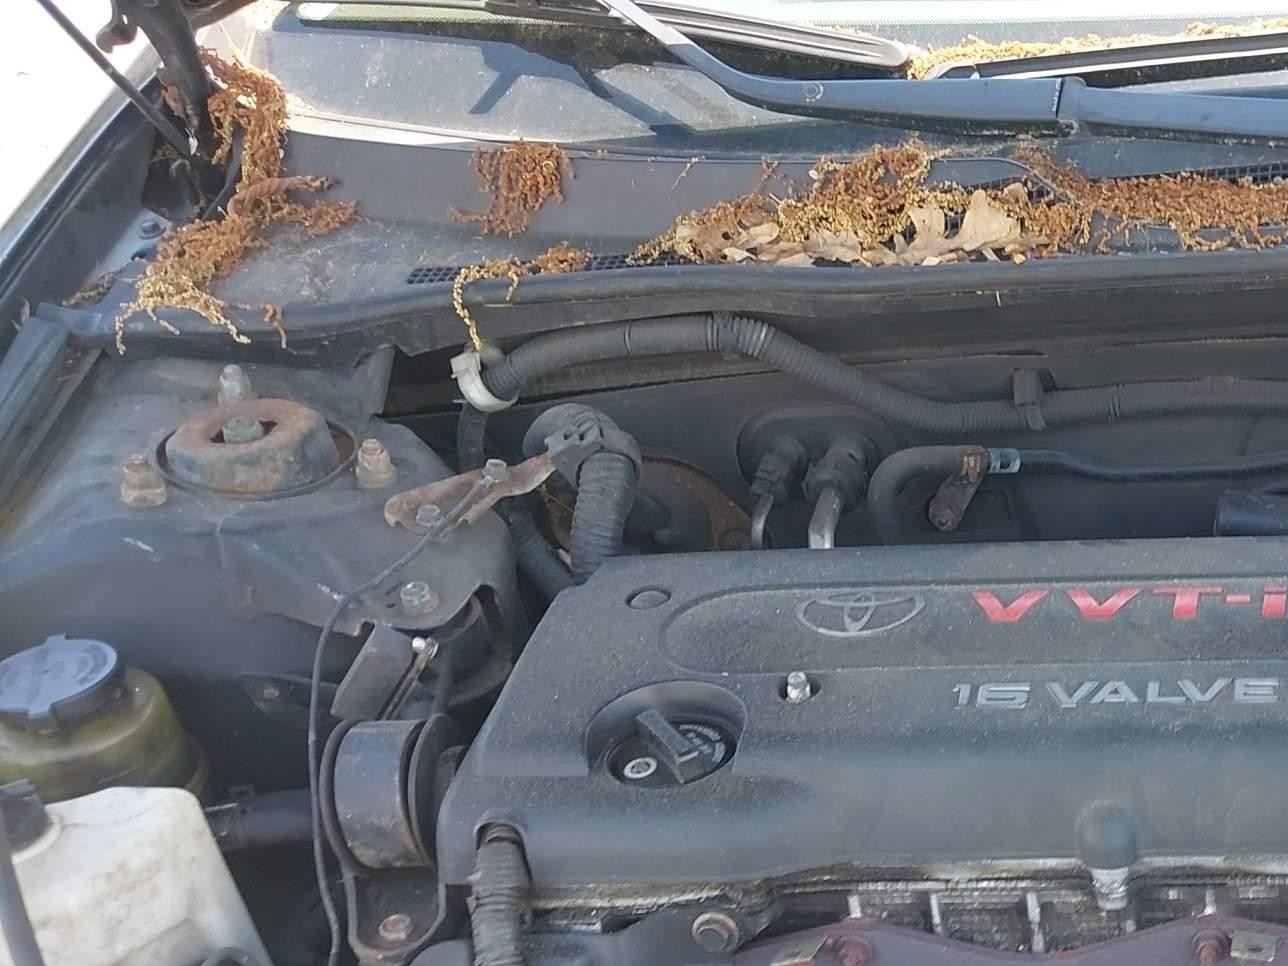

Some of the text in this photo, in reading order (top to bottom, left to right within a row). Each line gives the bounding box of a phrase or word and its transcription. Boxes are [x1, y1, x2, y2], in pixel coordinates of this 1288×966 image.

[971, 585, 1288, 622] VVT-i
[953, 677, 1280, 710] 16 VALVE
